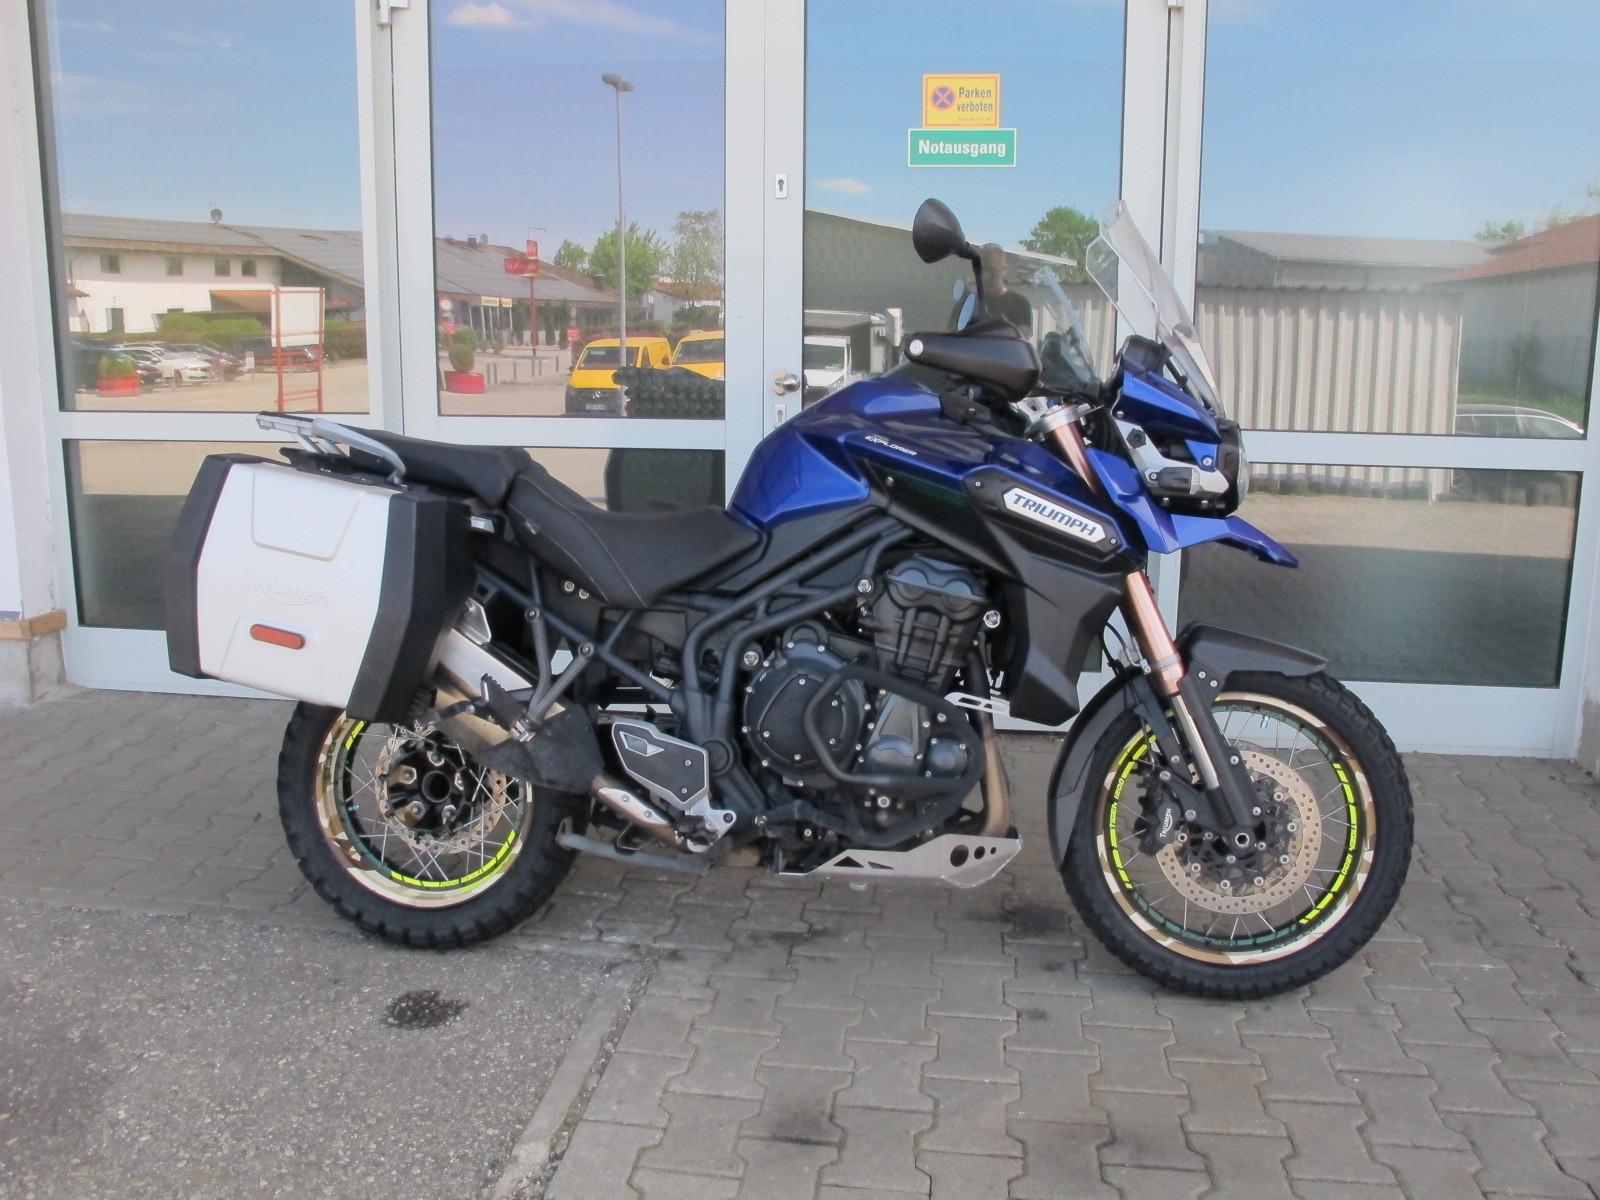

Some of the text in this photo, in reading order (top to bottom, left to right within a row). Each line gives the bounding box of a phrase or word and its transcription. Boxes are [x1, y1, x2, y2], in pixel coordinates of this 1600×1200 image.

[958, 86, 992, 99] Parken
[956, 101, 993, 112] verboten
[918, 139, 1006, 158] Notausgang
[1012, 492, 1098, 537] TRIUMPH
[1159, 808, 1173, 838] TRIUMPH
